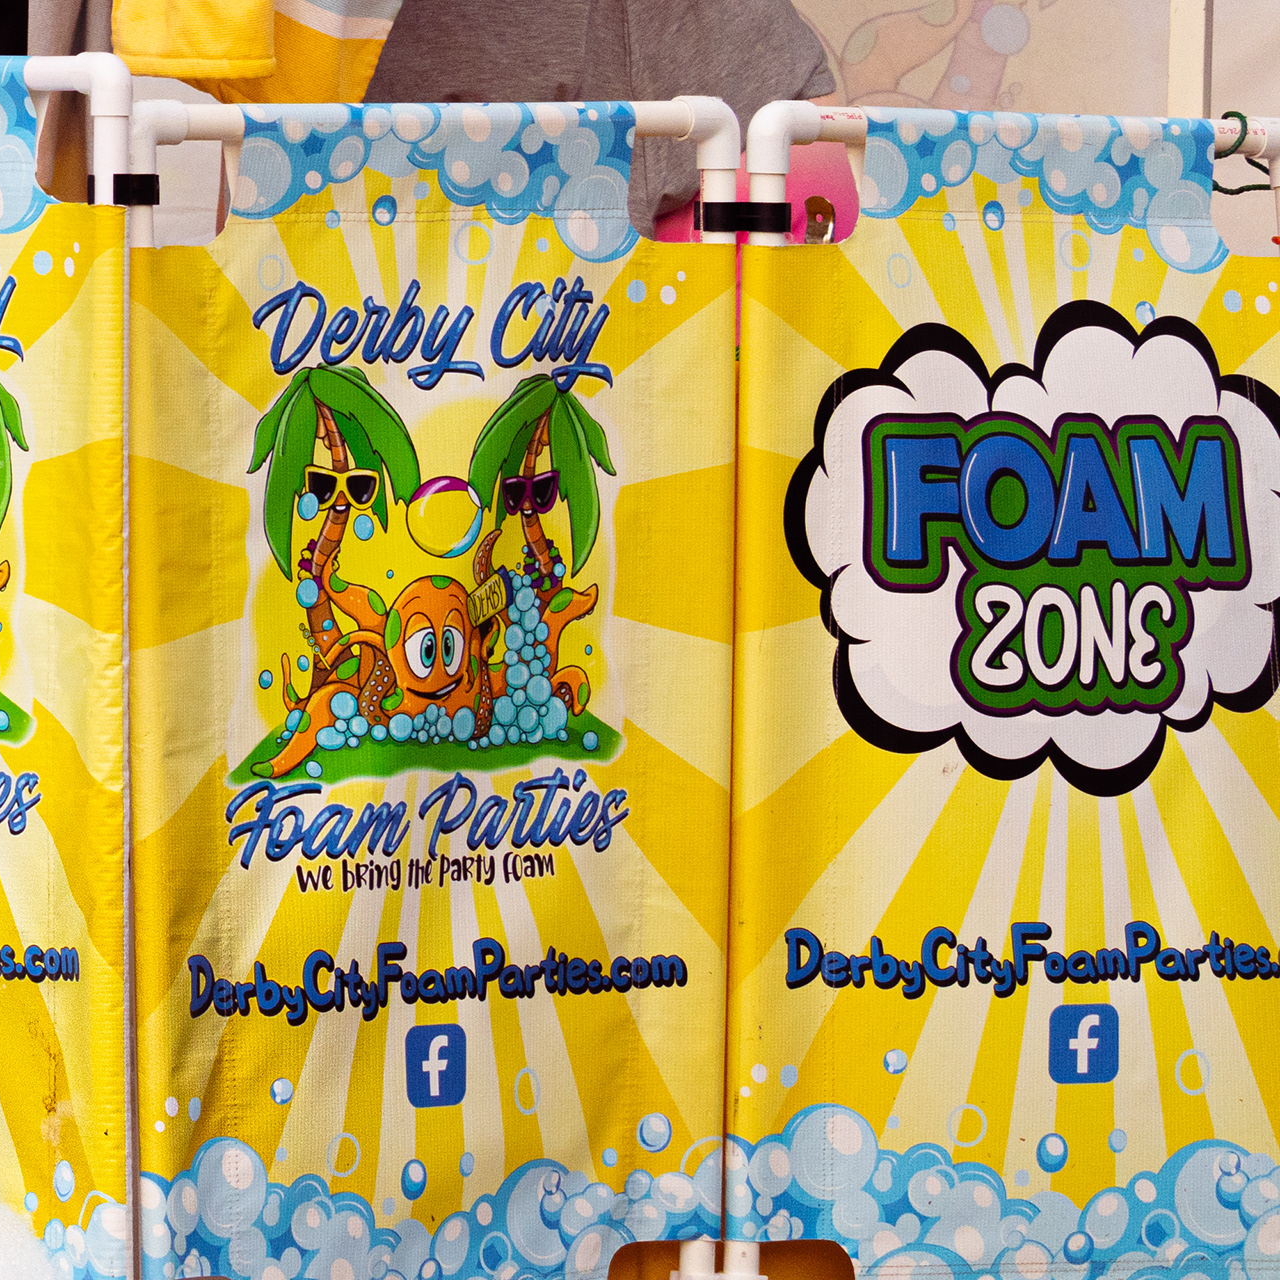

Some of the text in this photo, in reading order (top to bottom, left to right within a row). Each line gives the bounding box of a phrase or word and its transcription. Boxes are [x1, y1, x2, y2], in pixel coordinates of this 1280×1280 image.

[252, 275, 614, 393] Derby City
[882, 432, 1239, 572] FOAM
[968, 578, 1176, 692] ZONE
[225, 767, 630, 870] Foam Parties
[407, 857, 434, 889] the
[187, 936, 688, 1027] DerbyCityFoamParties.com
[783, 920, 1280, 1000] DerbyCityFoamParties.
